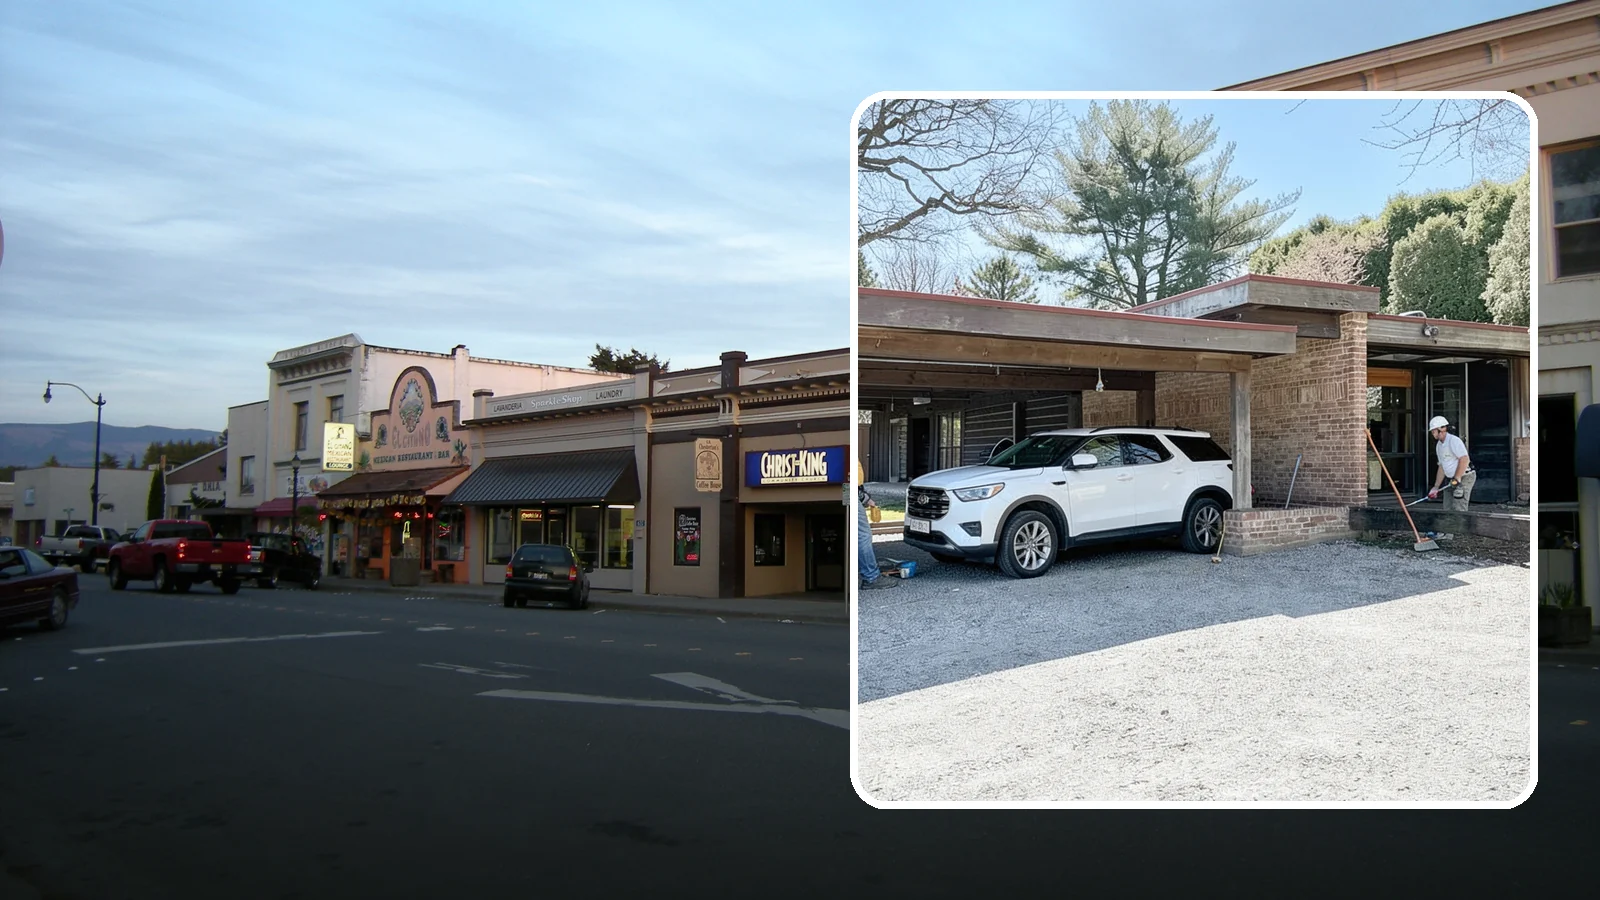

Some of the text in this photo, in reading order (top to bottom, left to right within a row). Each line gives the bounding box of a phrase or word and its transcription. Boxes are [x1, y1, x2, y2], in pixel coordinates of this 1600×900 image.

[494, 389, 624, 412] LAVANDERIA Sparkle Shop LAUNDRY
[374, 455, 396, 464] MEXICAN
[398, 451, 433, 462] RESTAURANT
[438, 450, 450, 459] BAR
[760, 450, 827, 478] CHRIST KING
[696, 480, 721, 488] Coffee House
